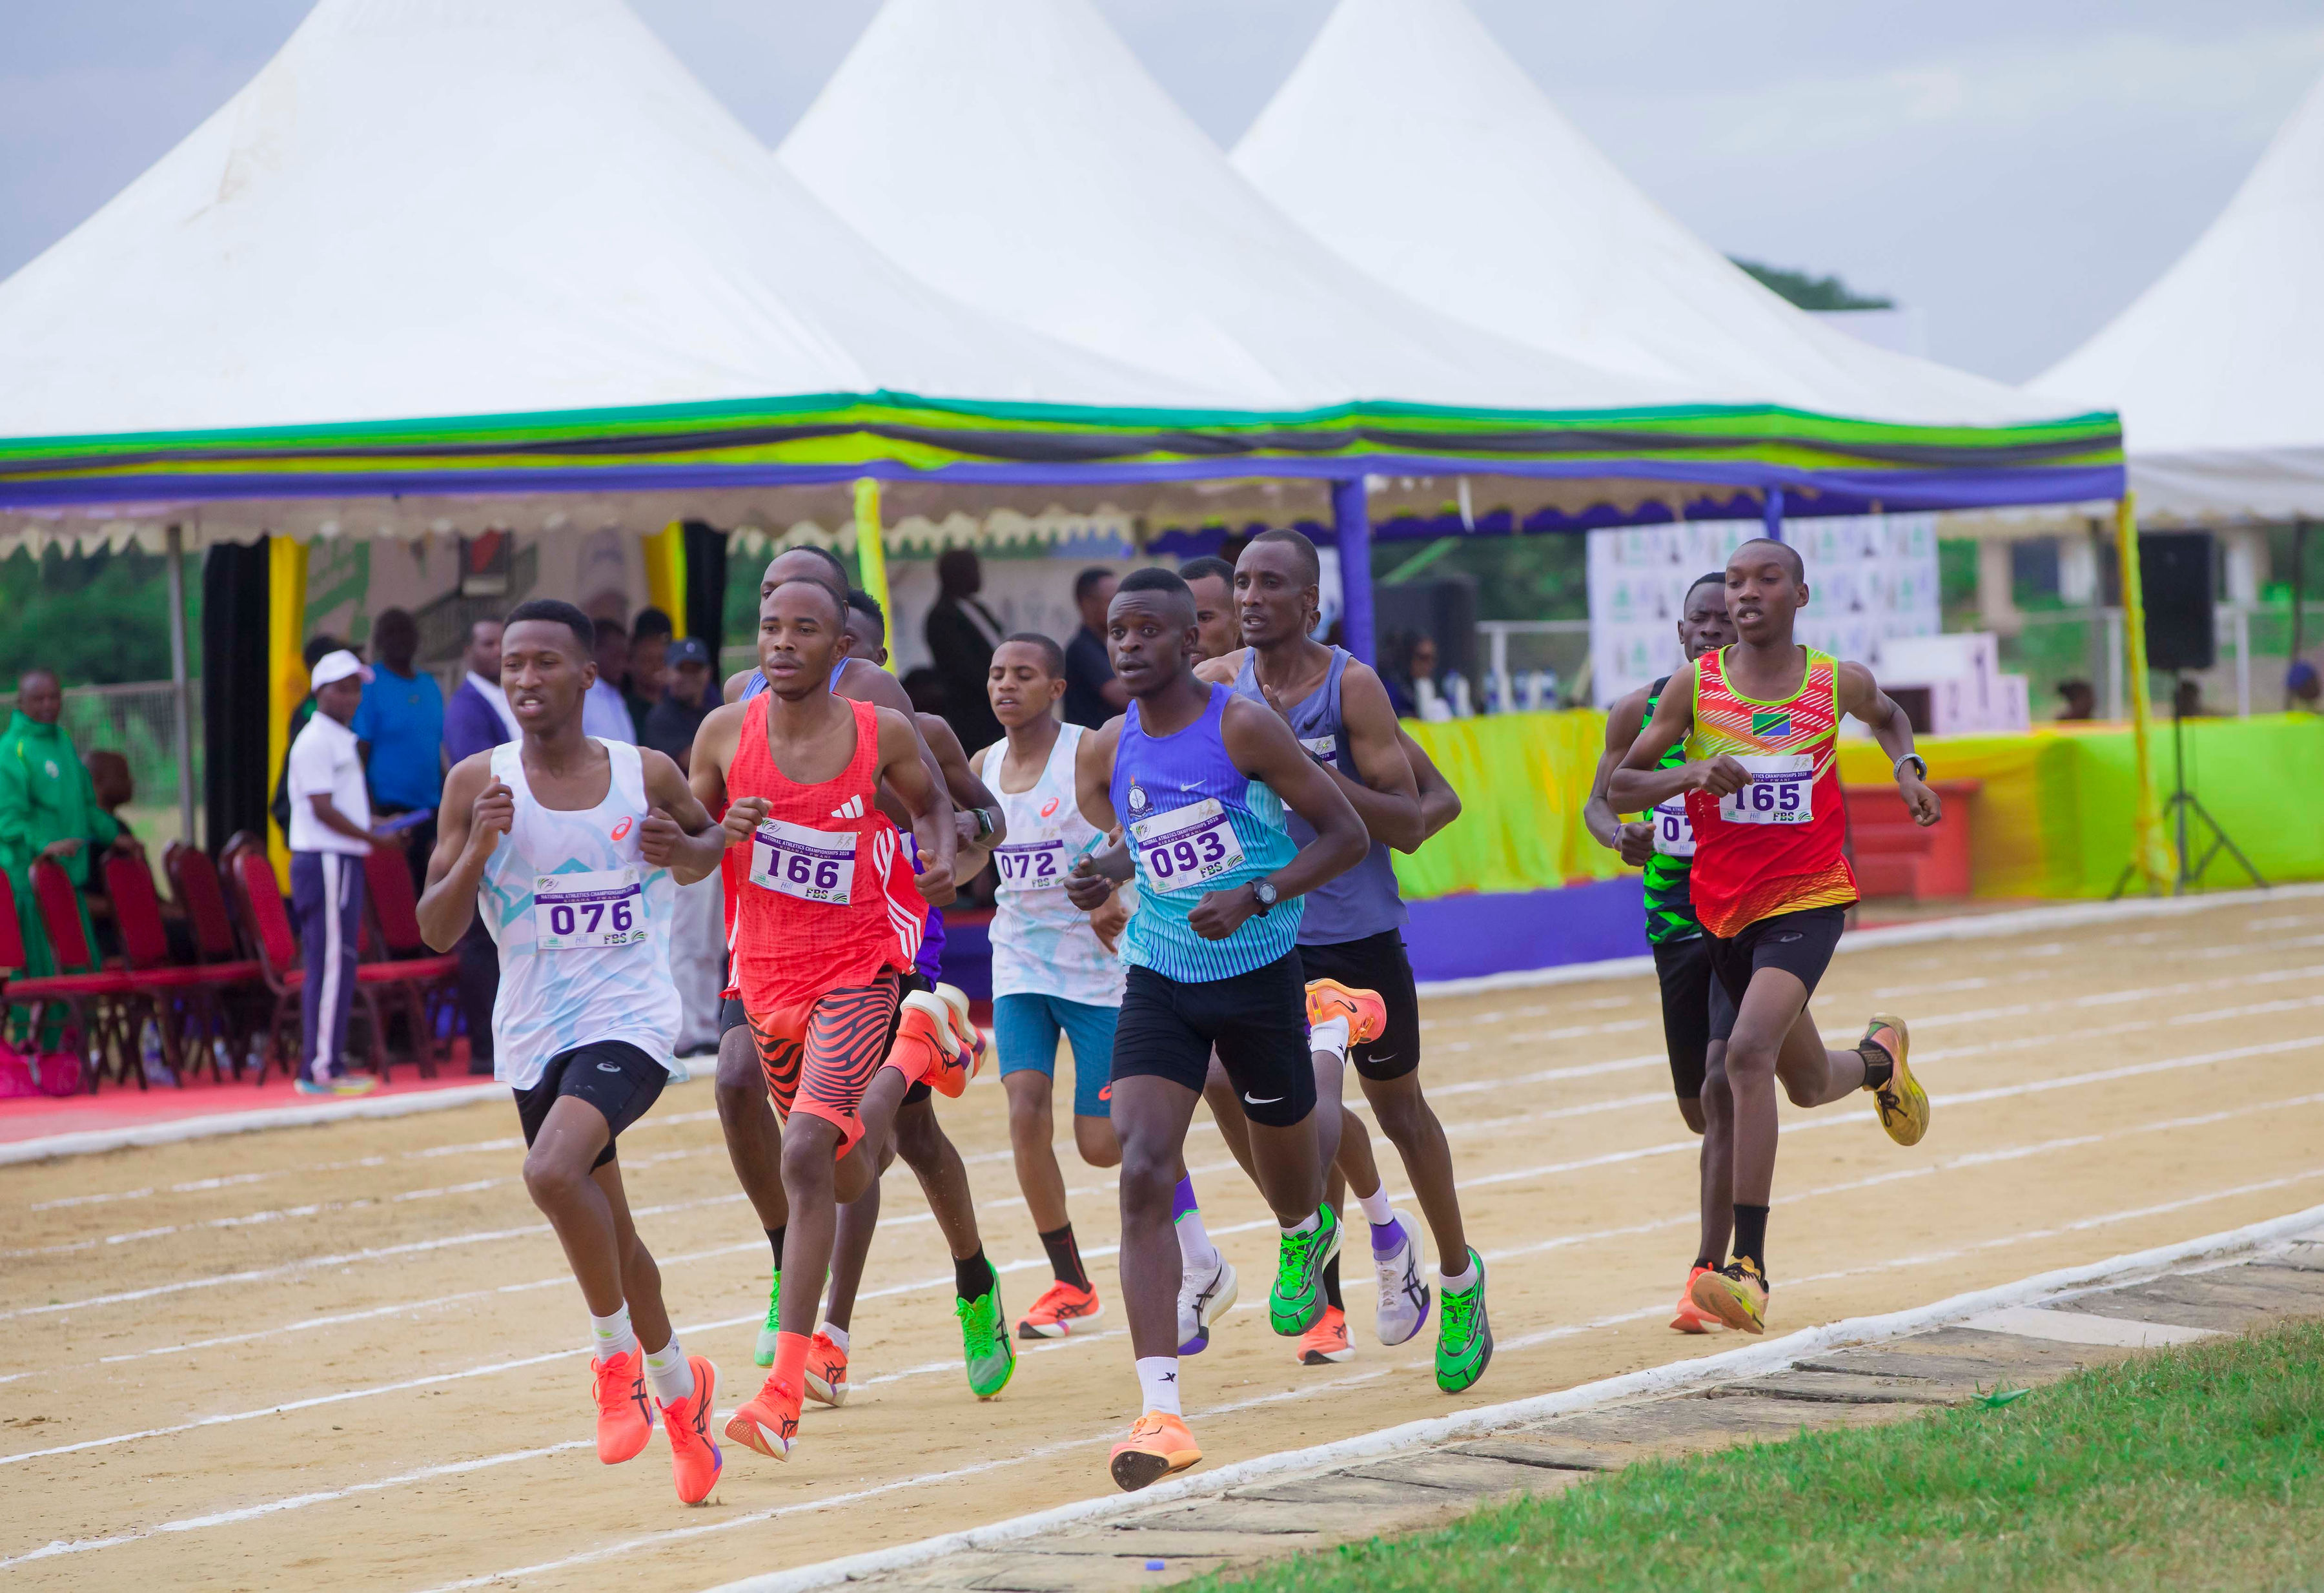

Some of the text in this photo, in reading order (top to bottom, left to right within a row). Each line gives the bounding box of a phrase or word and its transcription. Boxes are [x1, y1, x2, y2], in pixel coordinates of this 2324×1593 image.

[1735, 783, 1800, 811] 165
[1206, 816, 1219, 825] 2026
[1773, 812, 1795, 821] FBS
[762, 834, 781, 845] NATIONAL
[782, 841, 805, 850] ATHLETICS
[805, 846, 839, 856] CHAMPIONSHIPS
[1150, 832, 1226, 878] 093
[768, 848, 841, 889] 166
[1001, 852, 1056, 878] 072
[1199, 861, 1223, 878] FBS
[590, 889, 626, 897] CHAMPIONSHIPS
[805, 887, 828, 899] FBS
[551, 900, 633, 935] 076
[604, 932, 627, 945] FBS
